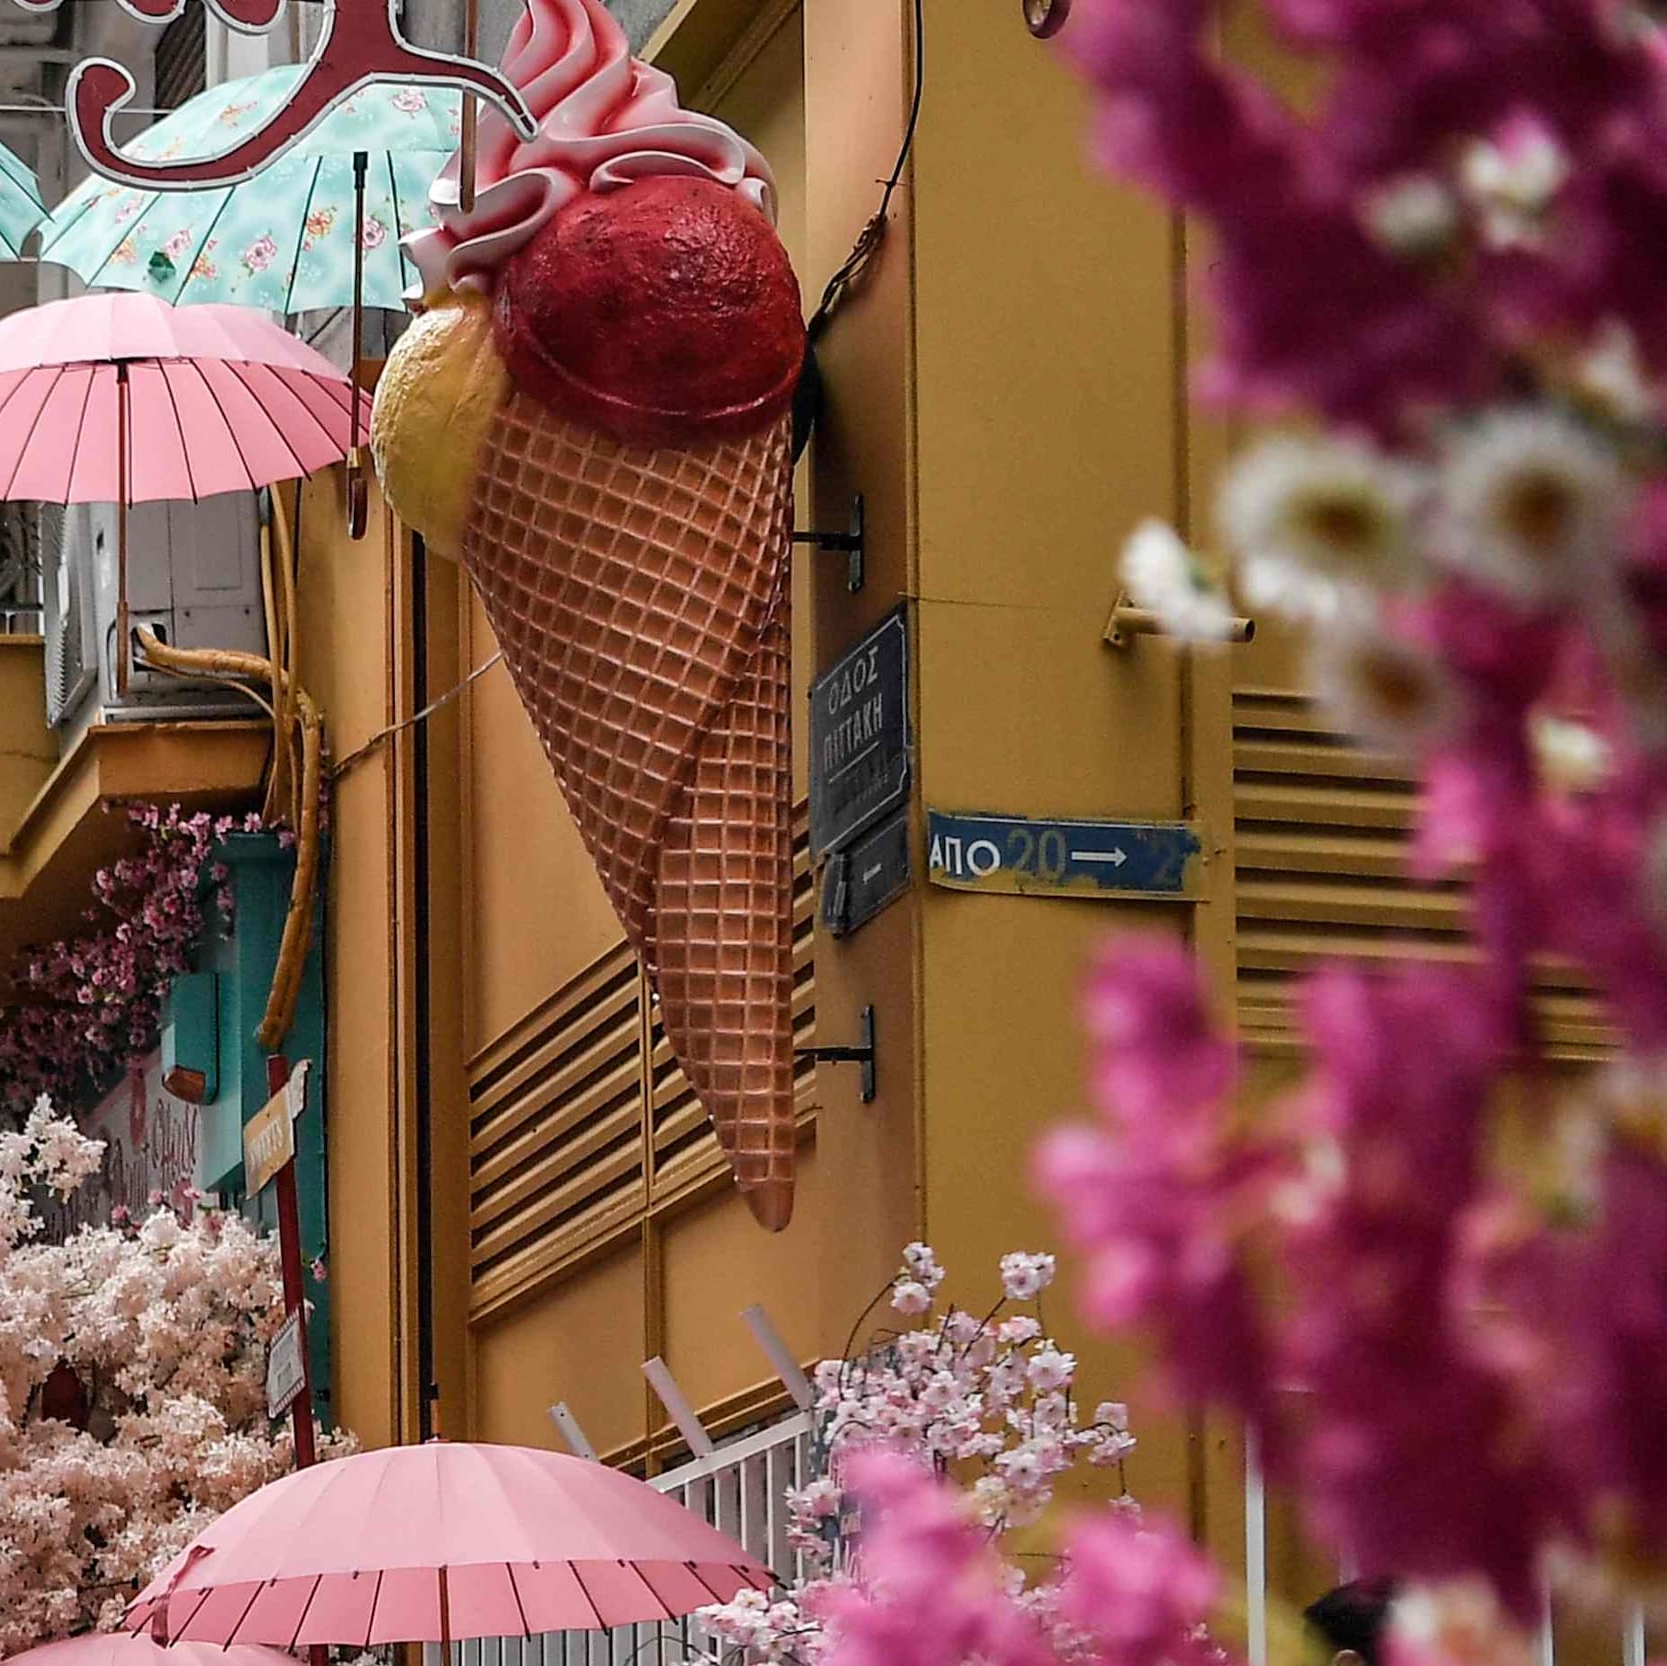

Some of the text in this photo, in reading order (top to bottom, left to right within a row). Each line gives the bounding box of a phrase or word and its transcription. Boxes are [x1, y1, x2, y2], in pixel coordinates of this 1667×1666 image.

[828, 645, 878, 715] ΟΔΟΣ
[823, 691, 883, 773] ΠΙΤΤΑΚΗ
[929, 833, 1001, 877] ΑΠΟ
[1007, 828, 1066, 881] 20
